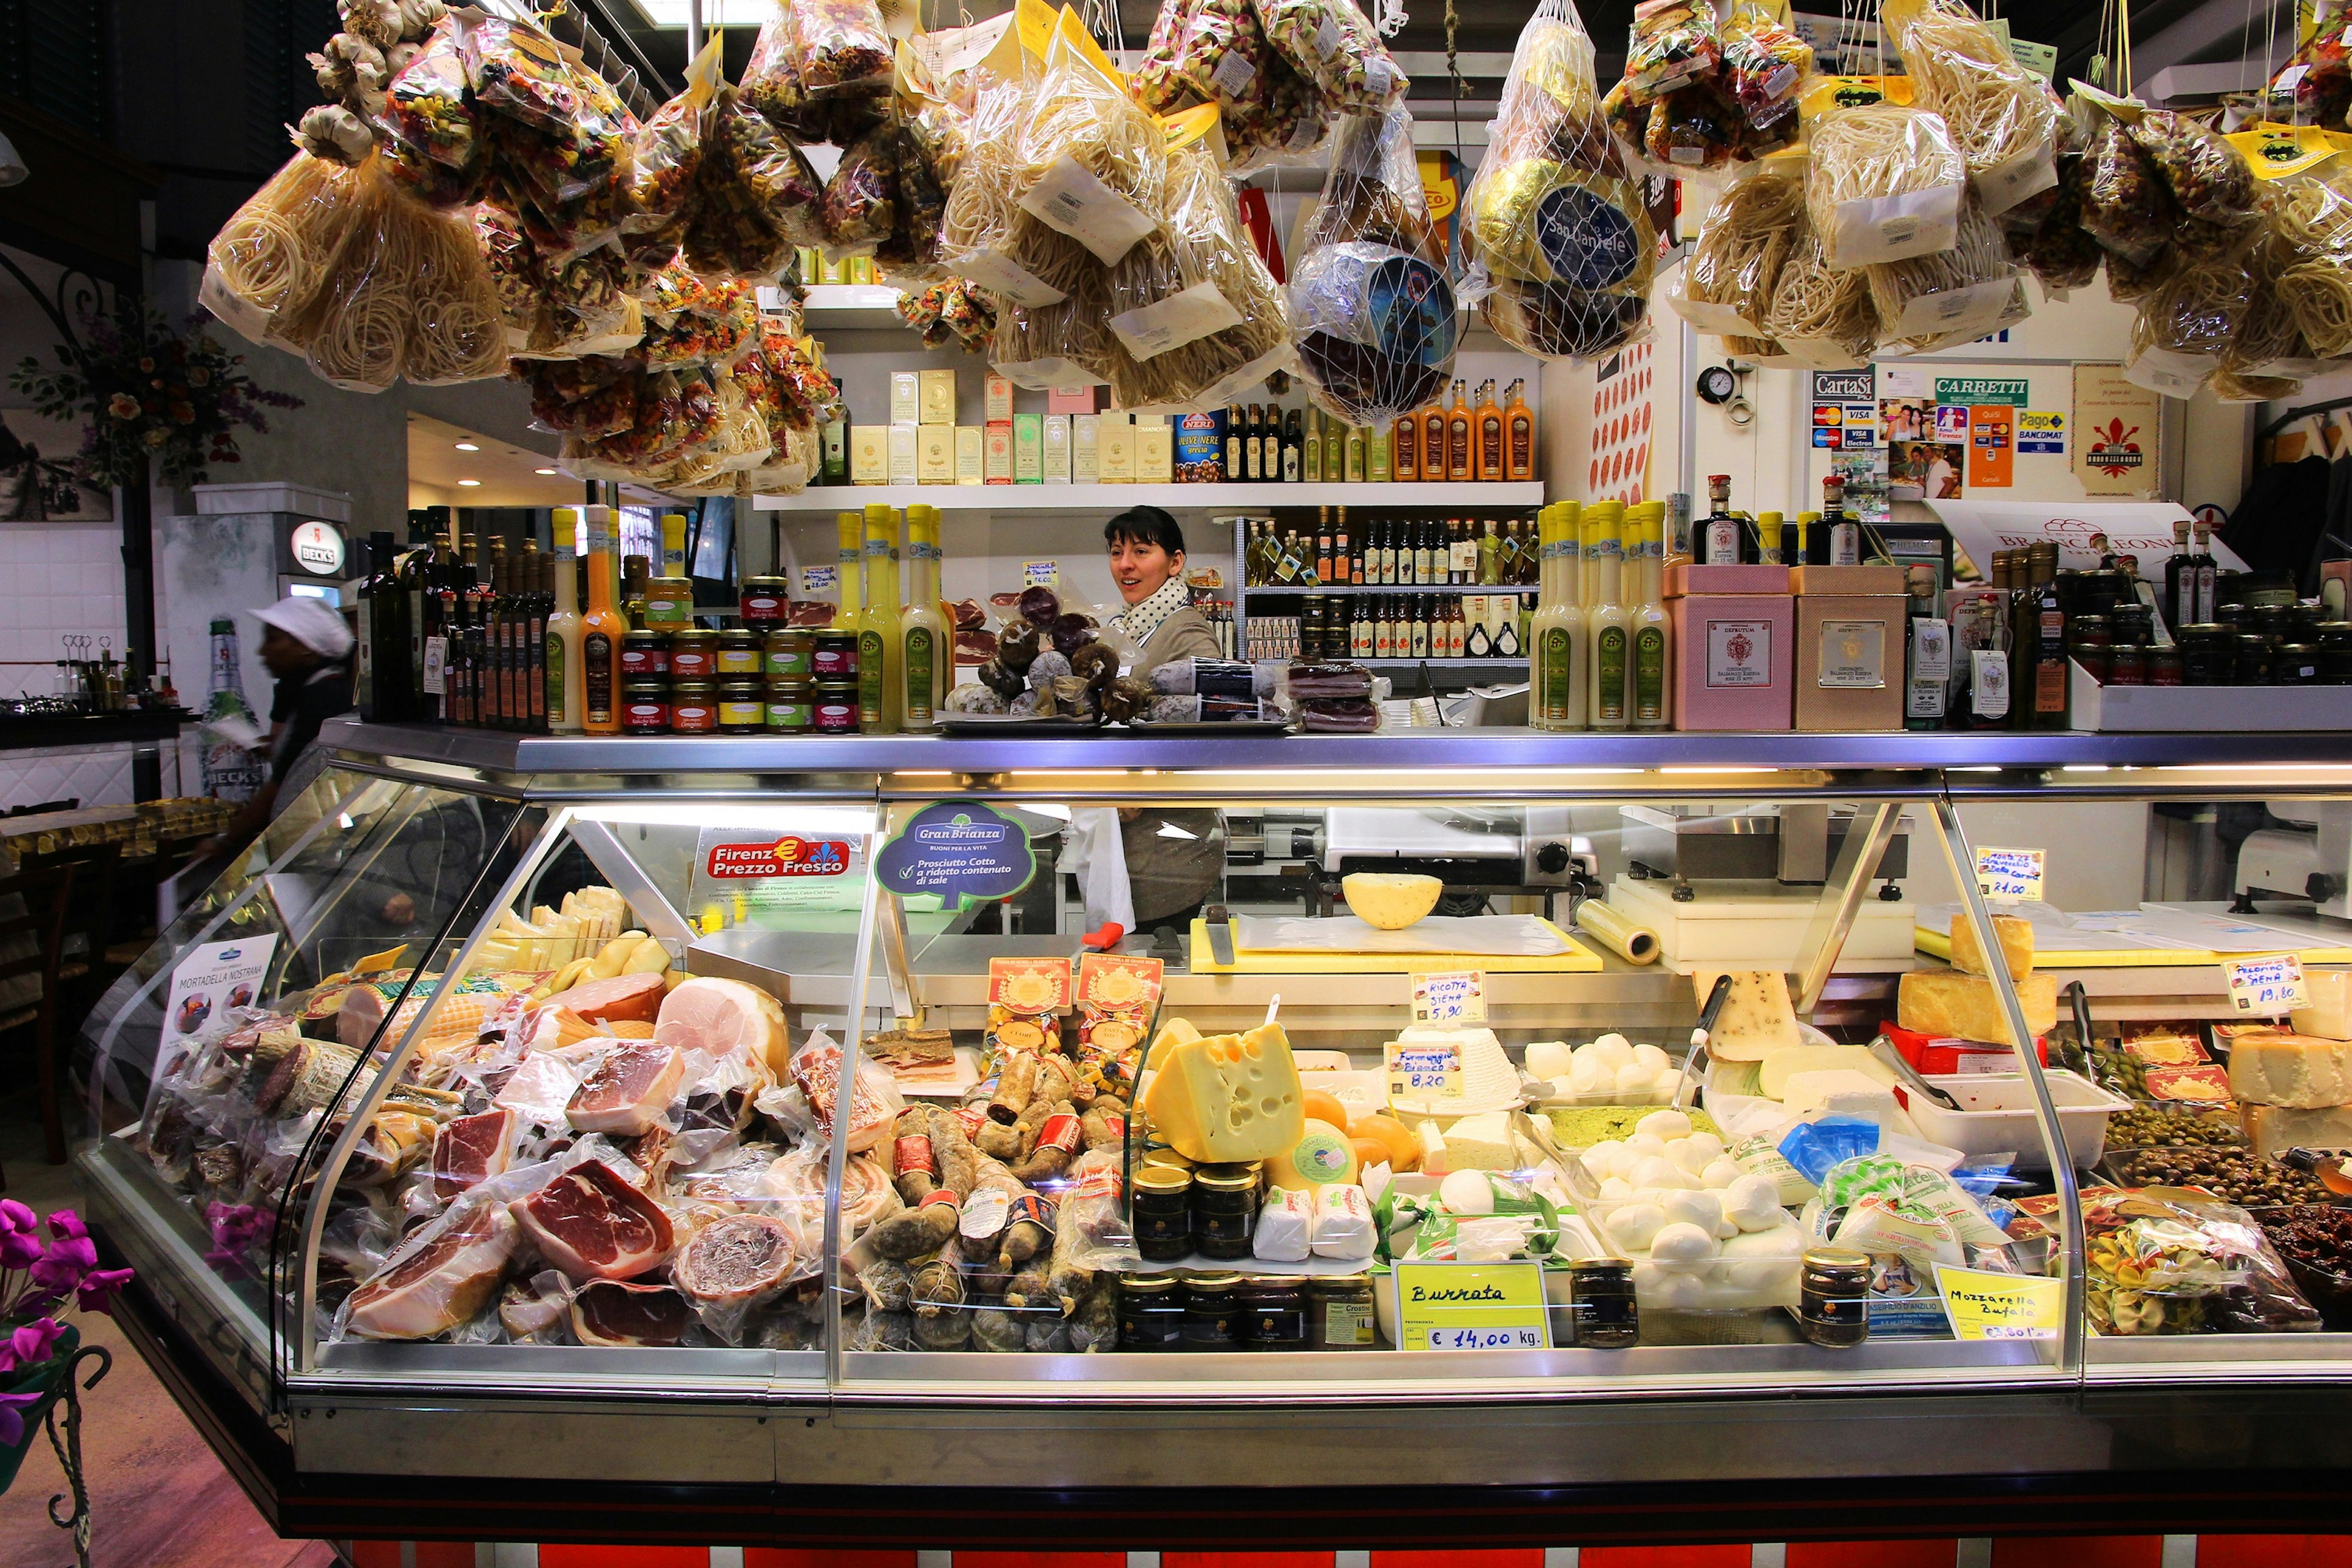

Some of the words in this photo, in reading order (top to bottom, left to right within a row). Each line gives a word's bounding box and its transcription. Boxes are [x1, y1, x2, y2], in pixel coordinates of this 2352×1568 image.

[1549, 221, 1570, 237] San
[1573, 228, 1626, 252] Daniele
[1936, 379, 2027, 394] CARRETTI
[2019, 412, 2049, 429] Pago
[1178, 436, 1199, 446] OLIVE
[1200, 436, 1219, 445] NERE
[2019, 431, 2063, 440] BANCOMAT
[302, 547, 334, 563] BECK'S
[919, 830, 949, 840] Gran
[951, 829, 1000, 839] Brianza
[713, 863, 777, 875] Prezzo
[782, 861, 843, 873] Fresco
[918, 859, 966, 869] Prosciutto
[969, 858, 996, 867] Cotto
[925, 867, 959, 876] ridotto
[962, 865, 1012, 875] contenuto
[916, 877, 926, 886] di
[928, 876, 948, 885] sale
[179, 973, 227, 990] MORTADELLA
[228, 965, 262, 981] NOSTRANA
[2260, 987, 2294, 1003] 19,80
[1431, 1006, 1463, 1020] 5,90
[1404, 1061, 1444, 1072] Bianco
[1412, 1074, 1446, 1088] 8,20
[1411, 1284, 1506, 1302] Burrata
[1951, 1291, 2036, 1306] Mozzarella
[1980, 1304, 2036, 1318] Bufala
[1431, 1332, 1442, 1345] €
[1453, 1329, 1510, 1349] 14,00
[1519, 1330, 1541, 1346] kg.
